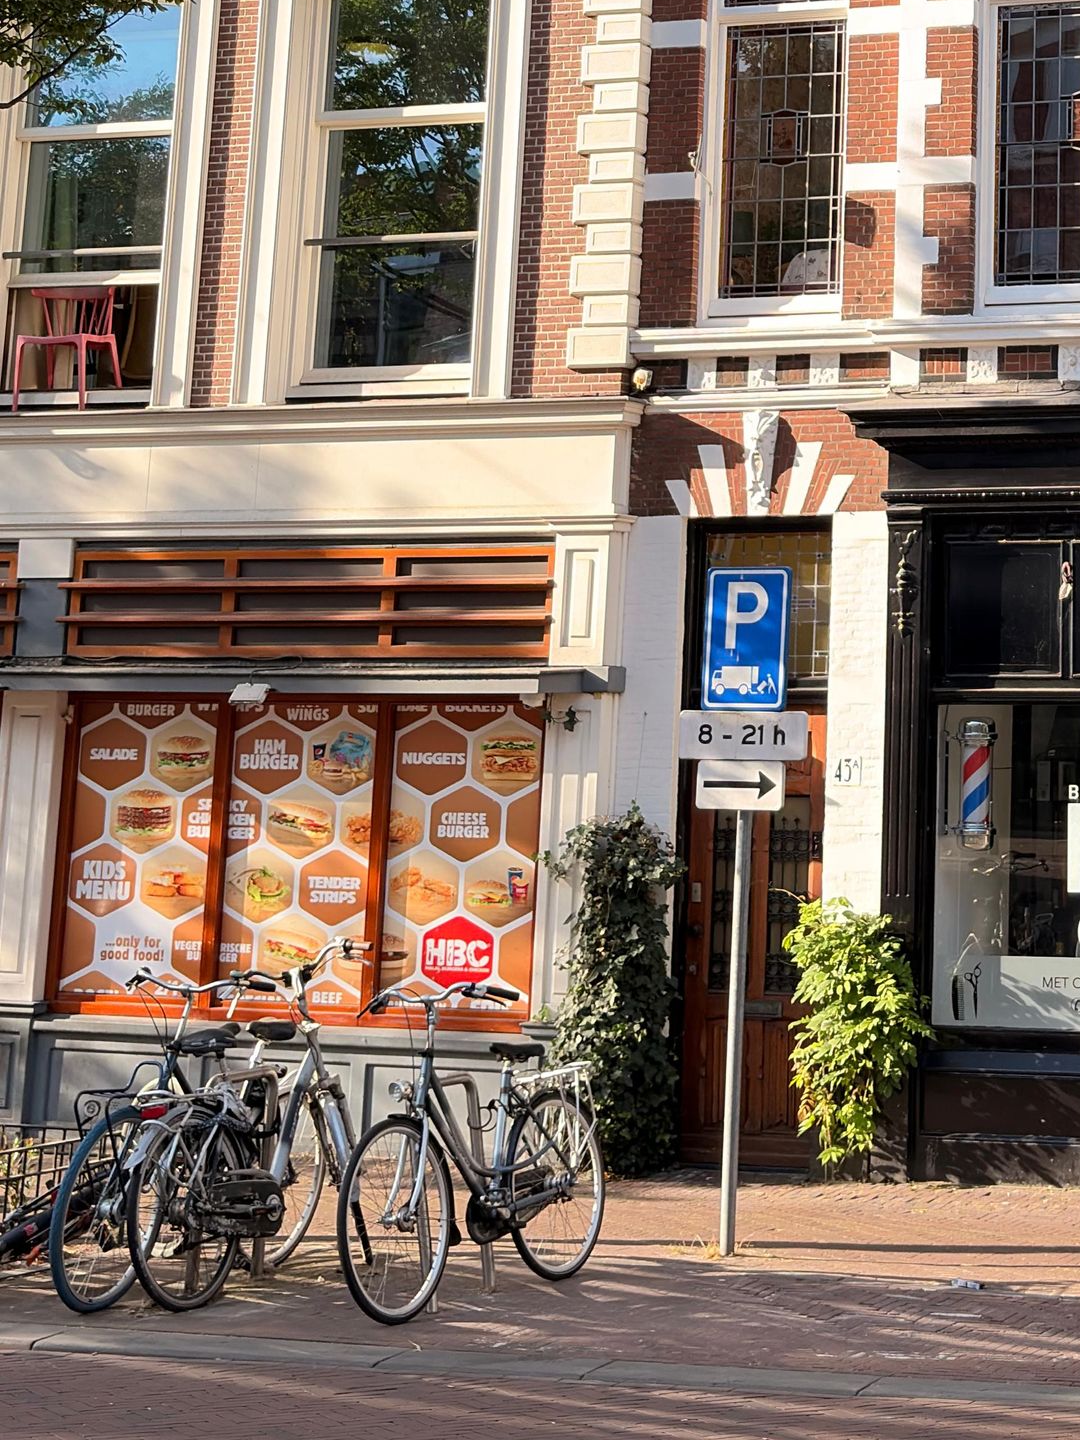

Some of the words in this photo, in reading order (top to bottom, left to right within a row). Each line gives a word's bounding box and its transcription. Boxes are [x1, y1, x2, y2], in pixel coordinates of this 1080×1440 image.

[725, 581, 769, 650] P
[286, 708, 329, 721] WINGS
[698, 725, 713, 744] 8
[741, 724, 764, 745] 21
[773, 724, 786, 745] h
[254, 739, 286, 755] HAM
[89, 748, 139, 761] SALADE
[401, 751, 466, 765] NUGGETS
[239, 754, 299, 771] BURGER
[441, 812, 487, 826] CHEESE
[437, 825, 490, 839] BURGER
[83, 860, 126, 880] KIDS
[307, 875, 361, 891] TENDER
[75, 880, 131, 901] MENU
[309, 890, 357, 905] STRIPS
[144, 936, 162, 948] for
[100, 949, 129, 962] good
[133, 949, 164, 962] food!
[425, 937, 491, 968] HBC
[1042, 976, 1069, 990] MET
[311, 991, 343, 1004] BEEF
